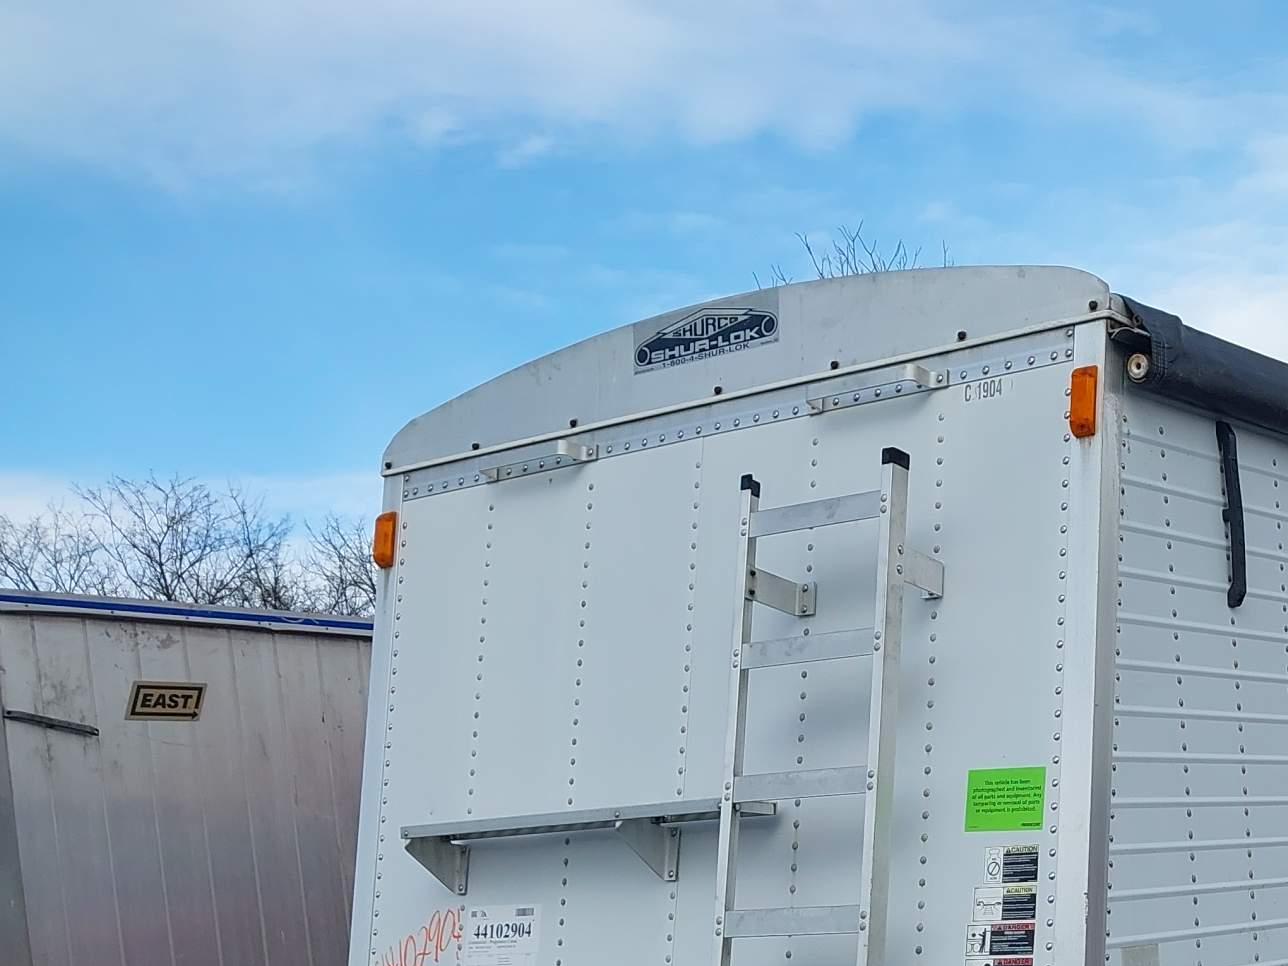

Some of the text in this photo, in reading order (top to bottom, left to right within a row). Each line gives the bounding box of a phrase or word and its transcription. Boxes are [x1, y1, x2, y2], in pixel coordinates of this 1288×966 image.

[650, 326, 760, 363] SHUR-LOK
[140, 693, 193, 709] EAST
[473, 921, 532, 939] 44102904
